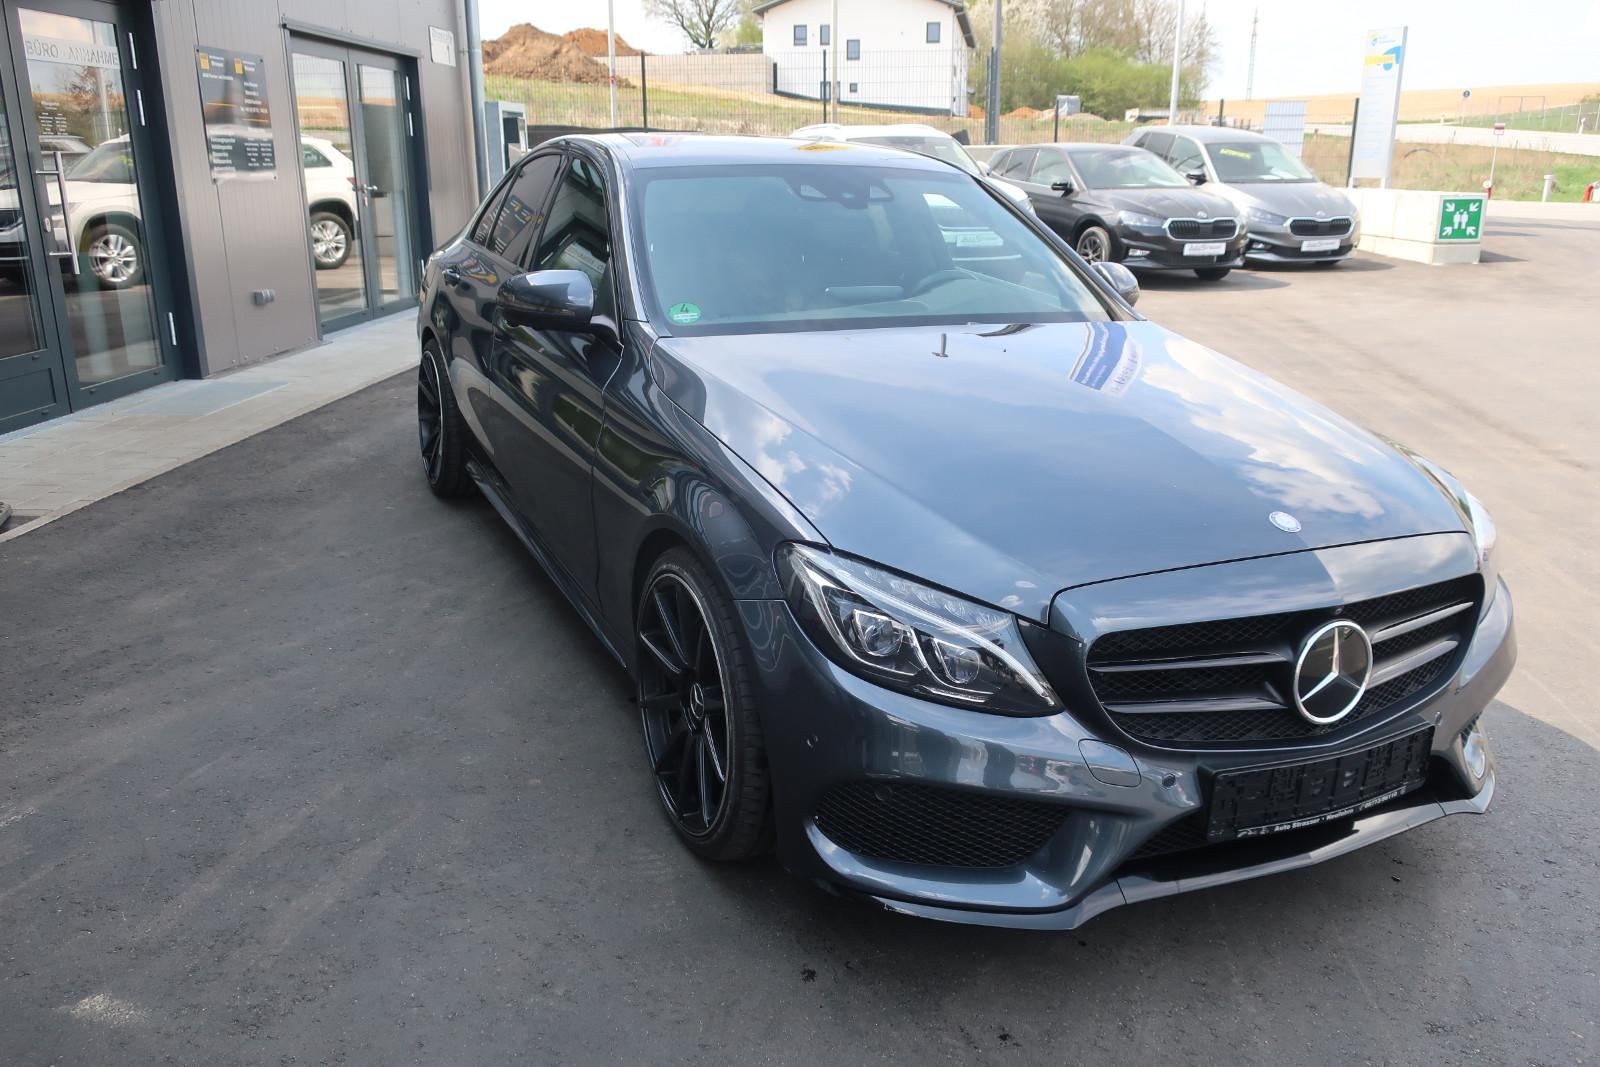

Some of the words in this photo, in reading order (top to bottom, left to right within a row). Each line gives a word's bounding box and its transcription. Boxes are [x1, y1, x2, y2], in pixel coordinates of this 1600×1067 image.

[25, 39, 59, 58] BÜRO
[68, 46, 120, 66] ANNAHME
[680, 303, 689, 313] 4
[1274, 824, 1291, 833] Auto
[1292, 817, 1320, 830] Strasser
